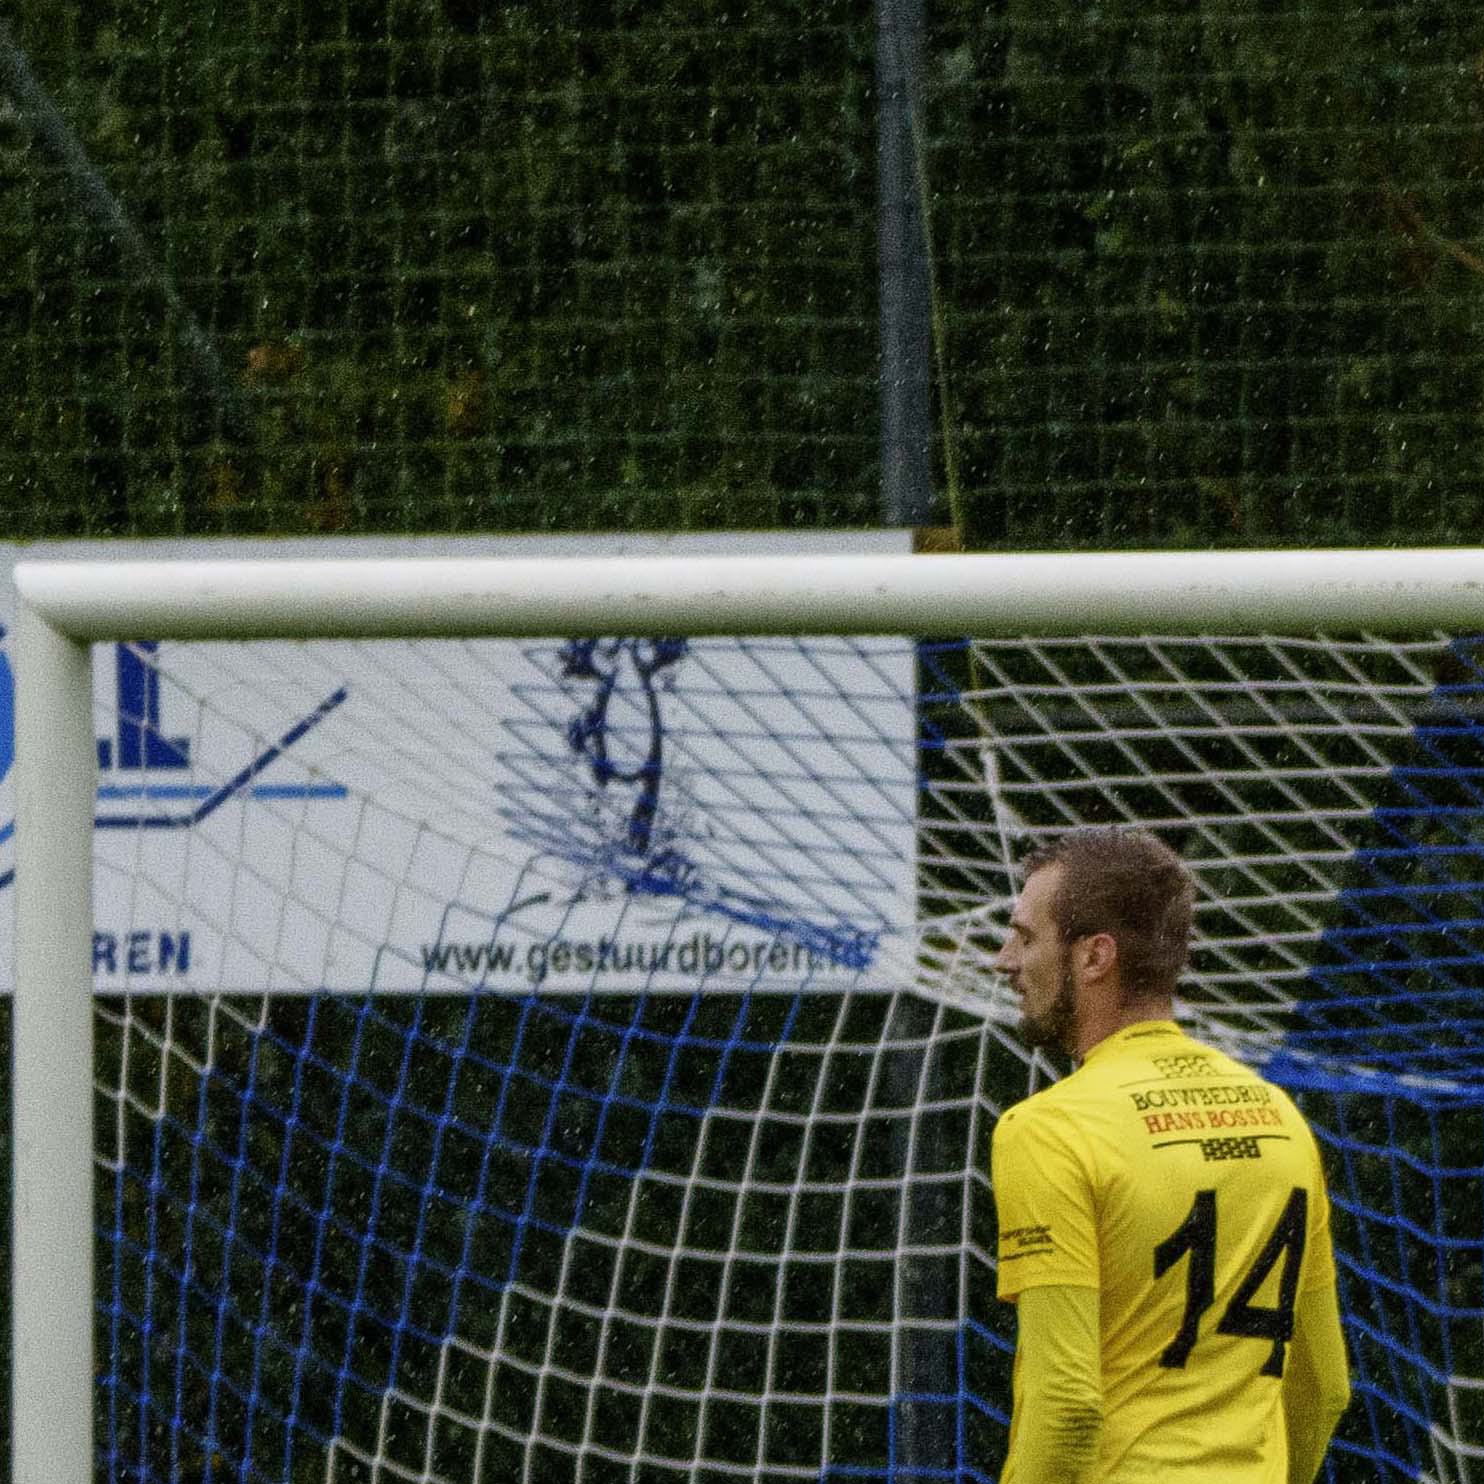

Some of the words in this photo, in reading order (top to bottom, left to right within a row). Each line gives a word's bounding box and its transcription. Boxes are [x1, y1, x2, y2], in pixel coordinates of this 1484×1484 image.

[421, 931, 868, 983] www.gestuurdboren.
[1142, 1110, 1205, 1135] HANS
[1206, 1107, 1283, 1129] BOSSEN
[1153, 1186, 1308, 1379] 14
